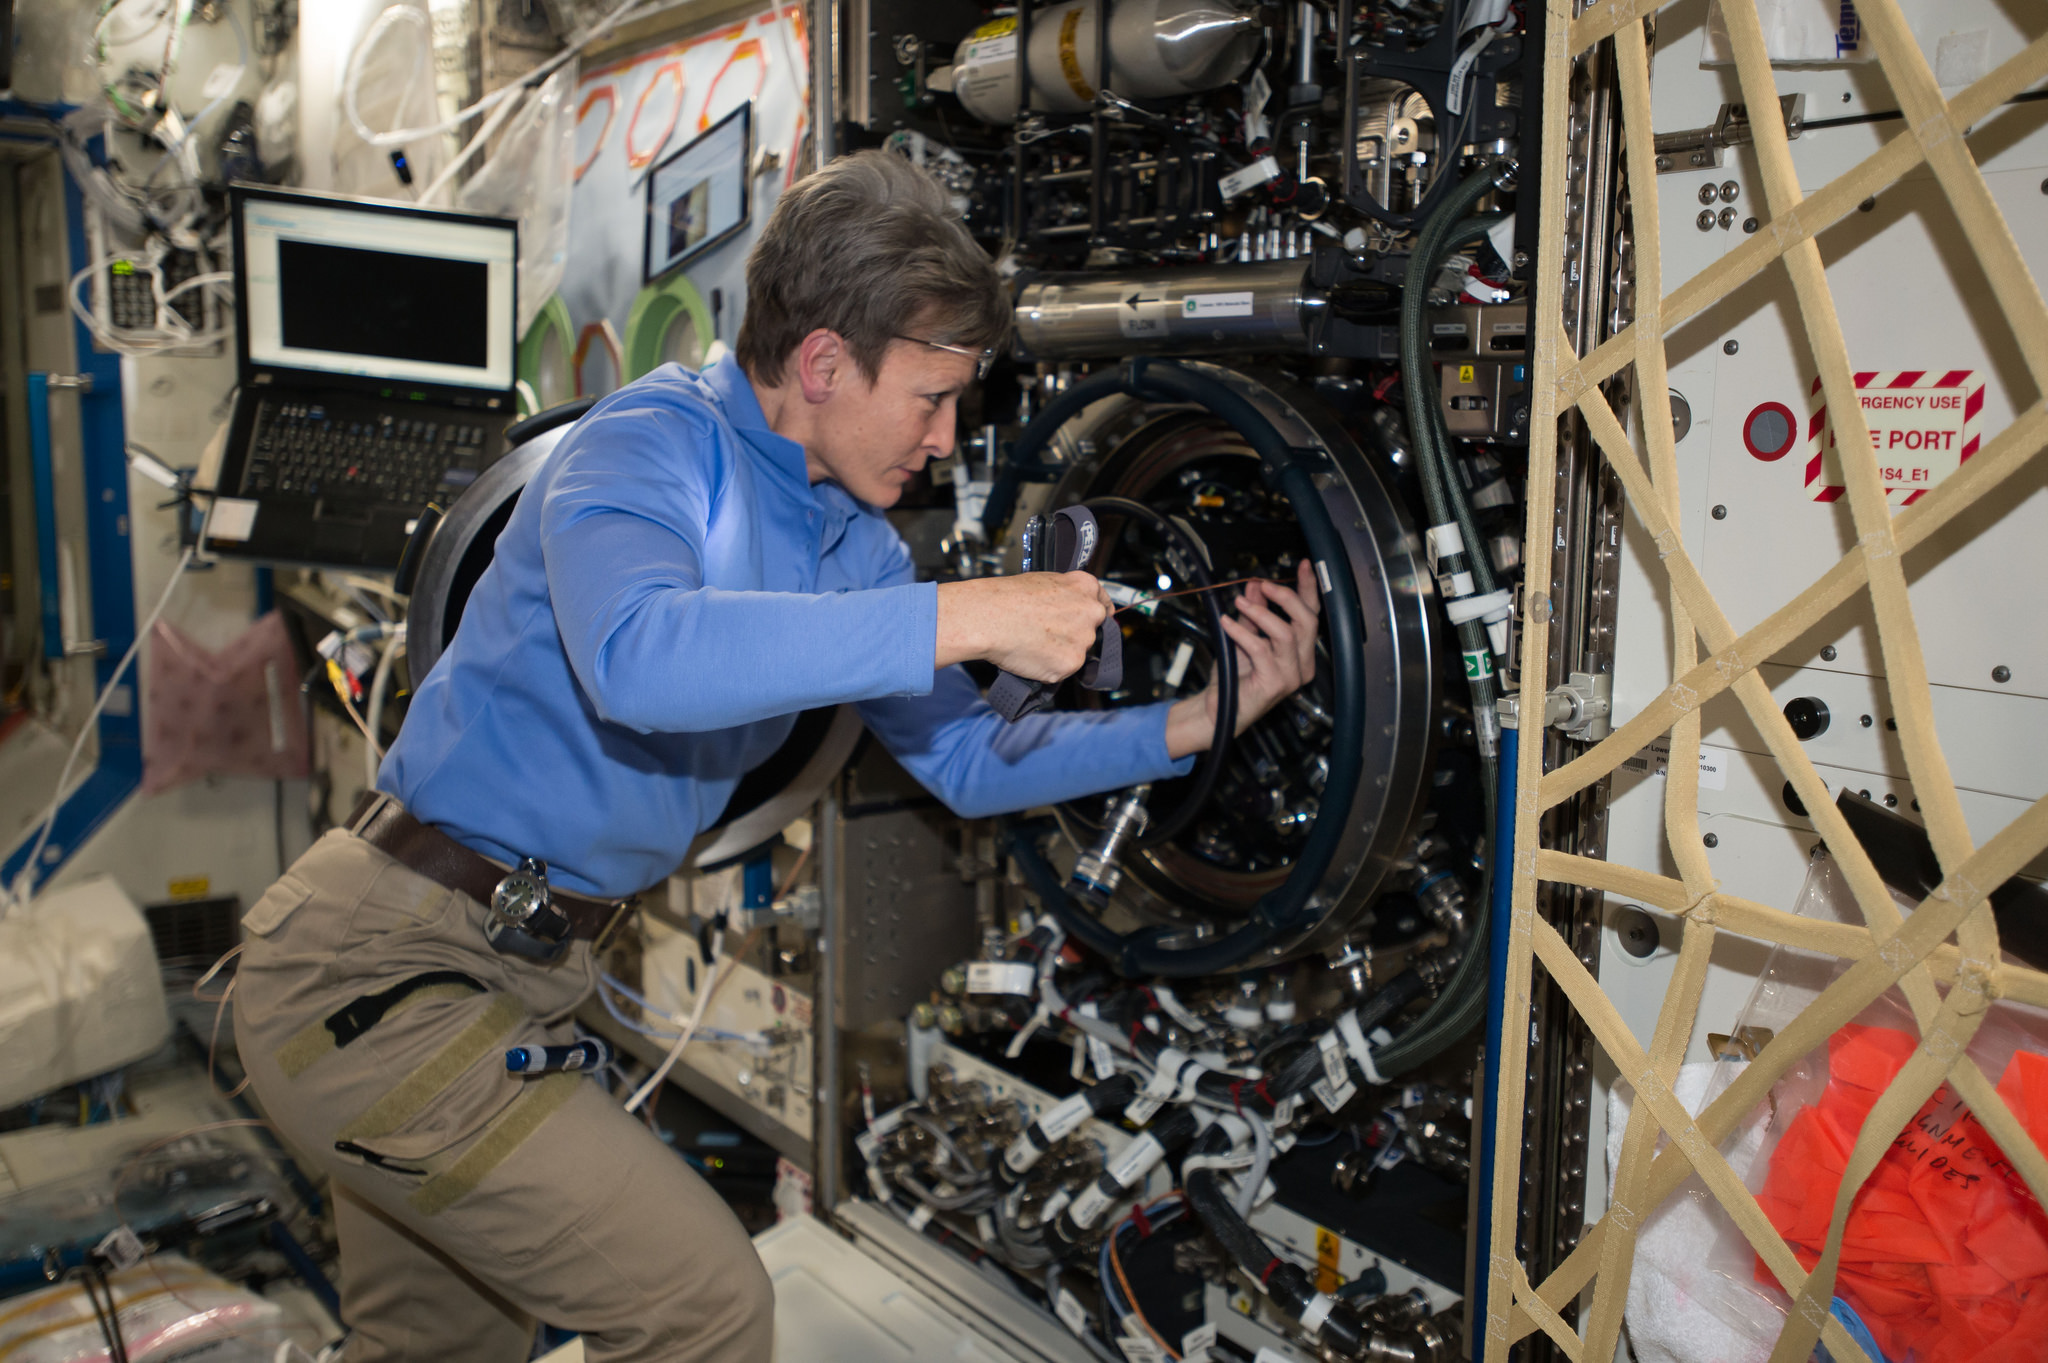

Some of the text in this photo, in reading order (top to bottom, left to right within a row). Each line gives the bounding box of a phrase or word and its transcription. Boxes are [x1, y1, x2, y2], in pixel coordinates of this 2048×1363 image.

[1835, 0, 1859, 58] Tem
[1857, 396, 1961, 409] RGENCY USE
[1889, 430, 1957, 450] PORT
[1656, 756, 1667, 764] P/N
[1655, 769, 1666, 777] S/N
